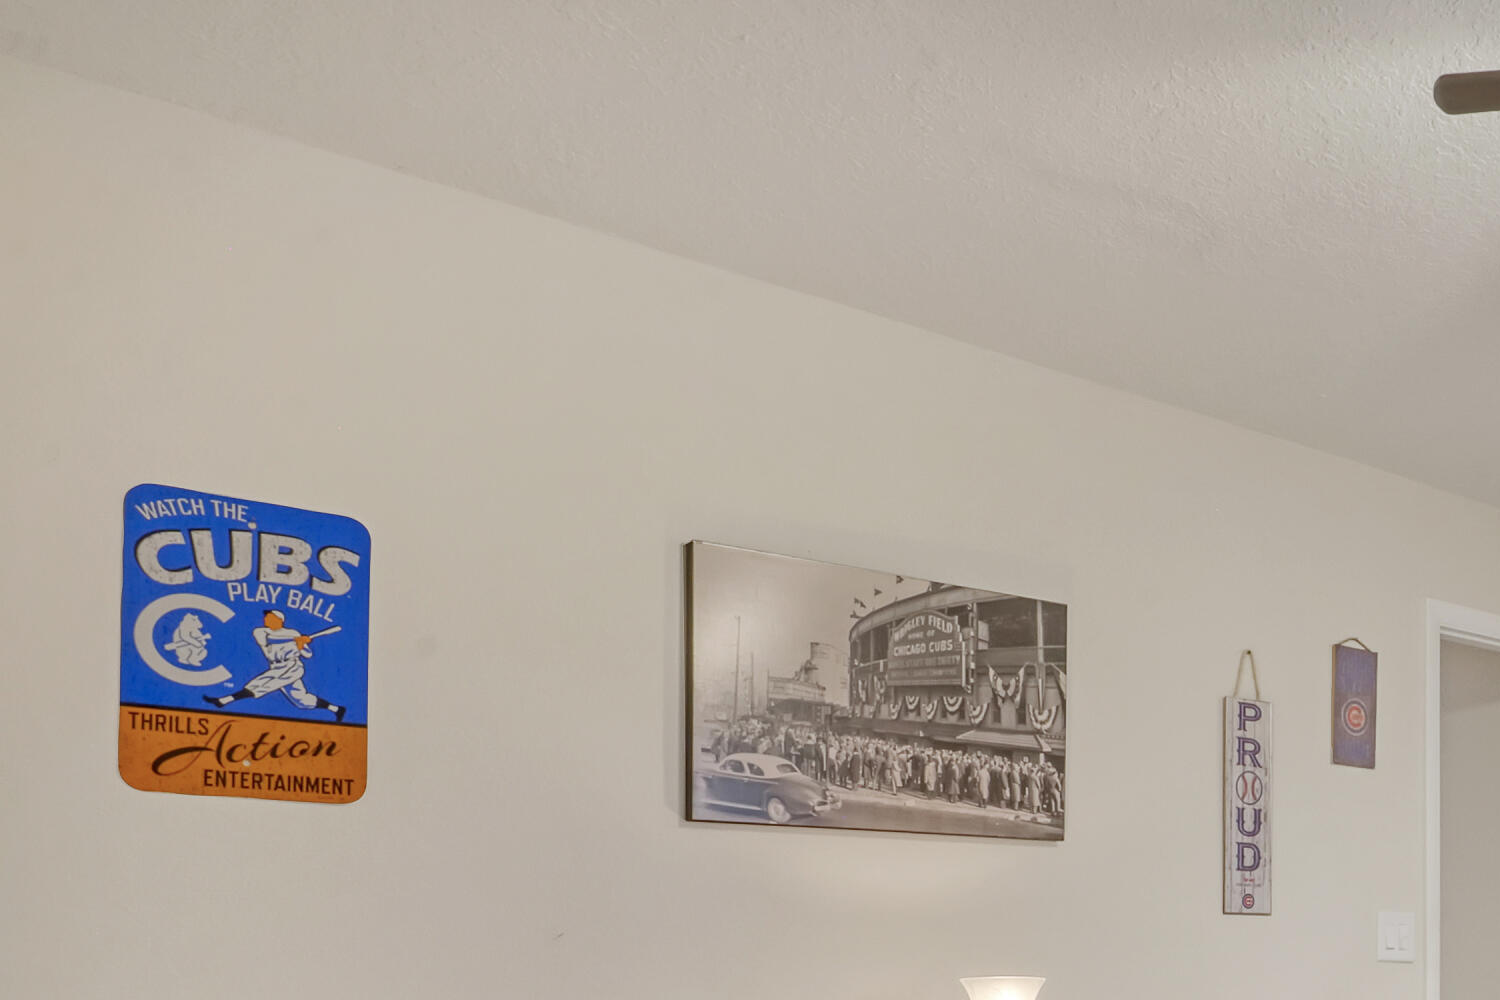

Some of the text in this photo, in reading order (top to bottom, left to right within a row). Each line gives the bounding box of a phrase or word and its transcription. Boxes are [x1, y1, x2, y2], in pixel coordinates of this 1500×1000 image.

[135, 498, 248, 522] WATCH THE
[133, 528, 361, 596] CUBS
[227, 582, 335, 622] PLAY BALL
[928, 614, 953, 633] FIELD
[929, 640, 953, 653] CUBS
[128, 711, 209, 736] THRILLS
[152, 719, 341, 777] Action
[203, 768, 354, 796] ENTERTAINMENT
